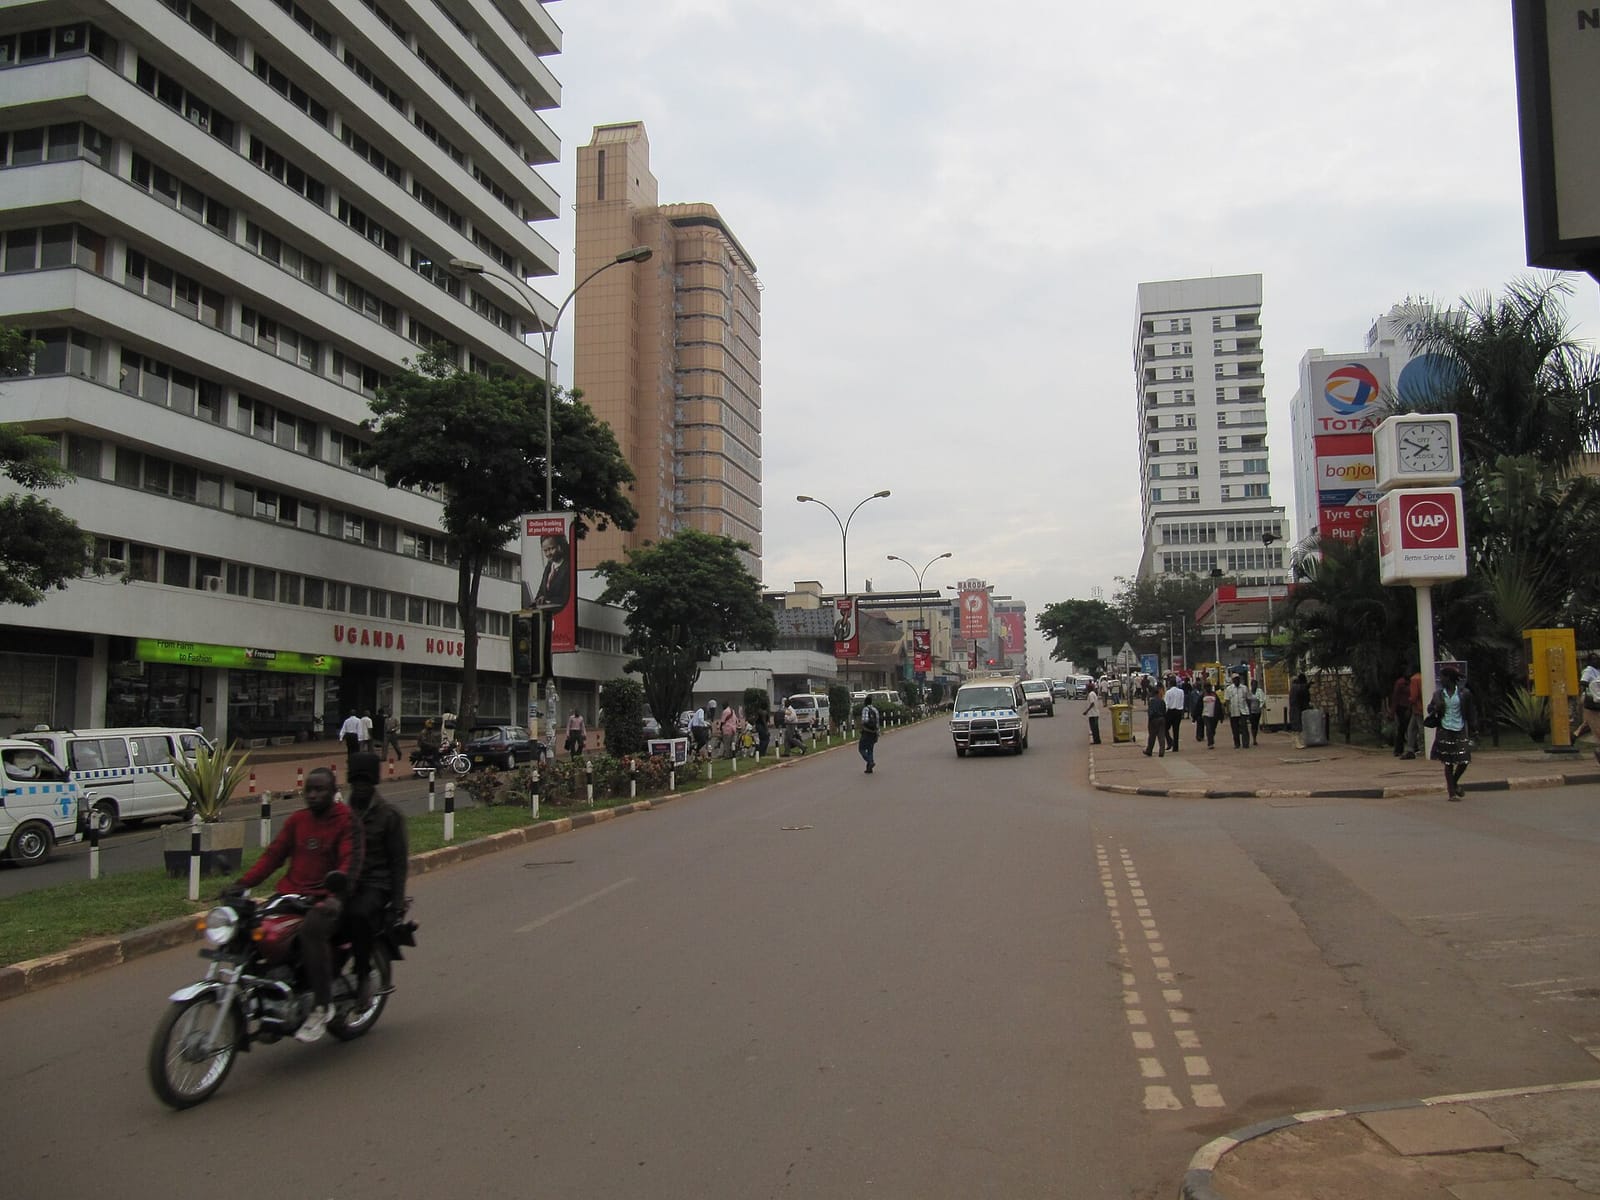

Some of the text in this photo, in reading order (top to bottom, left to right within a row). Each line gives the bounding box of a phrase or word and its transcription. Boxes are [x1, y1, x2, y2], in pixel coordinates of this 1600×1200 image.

[1577, 7, 1600, 30] N
[1326, 510, 1351, 522] Tyre
[1411, 514, 1445, 527] UAP
[157, 639, 176, 649] From
[334, 624, 465, 657] UGANDA HOUS
[179, 653, 213, 665] to Fashion
